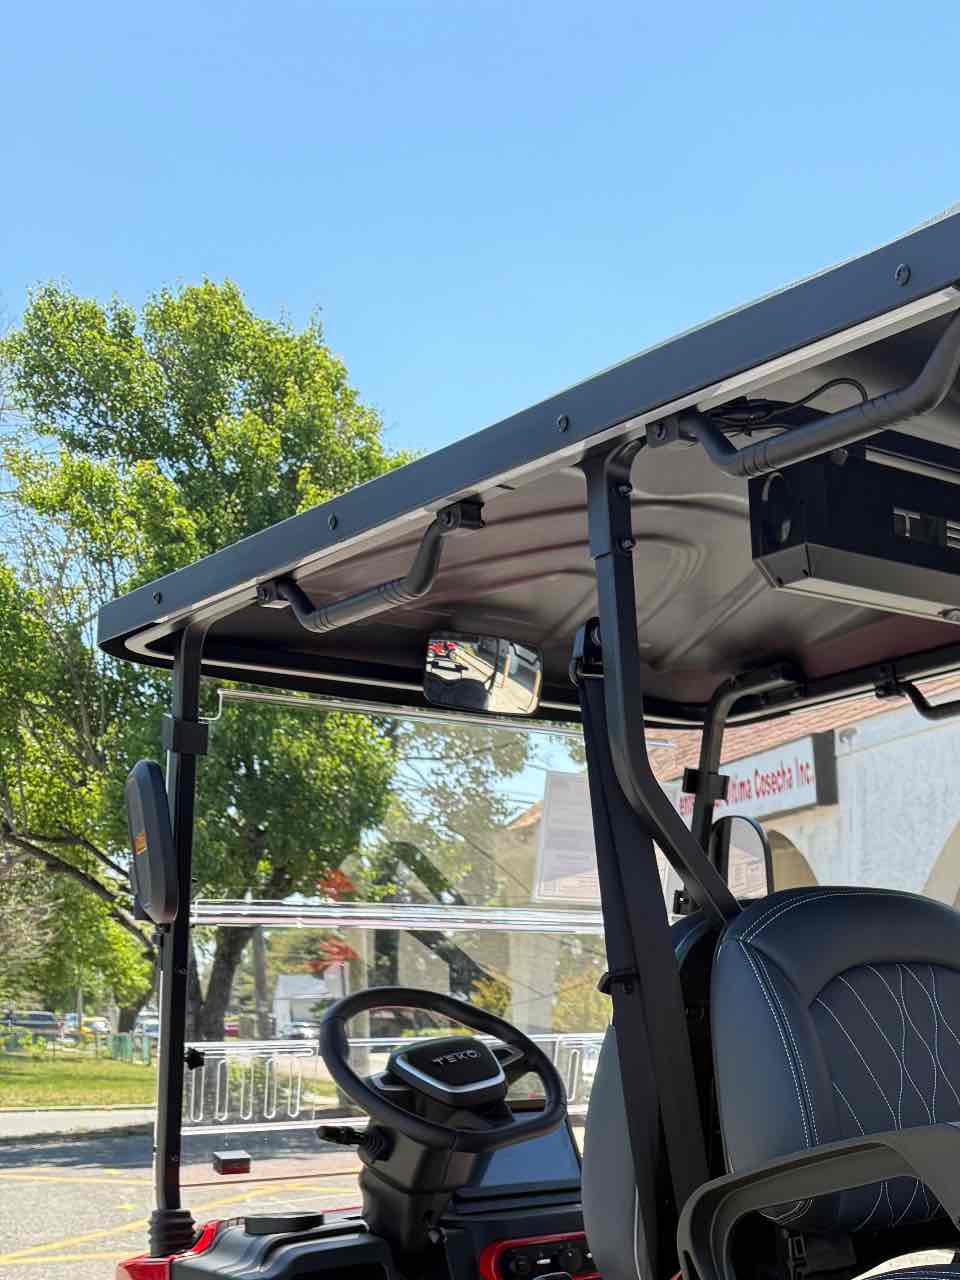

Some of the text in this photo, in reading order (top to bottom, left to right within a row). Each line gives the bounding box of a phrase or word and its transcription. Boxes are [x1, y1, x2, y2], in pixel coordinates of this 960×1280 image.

[754, 761, 793, 799] Cosecha
[794, 756, 815, 786] Inc.
[432, 1049, 478, 1064] TEKO
